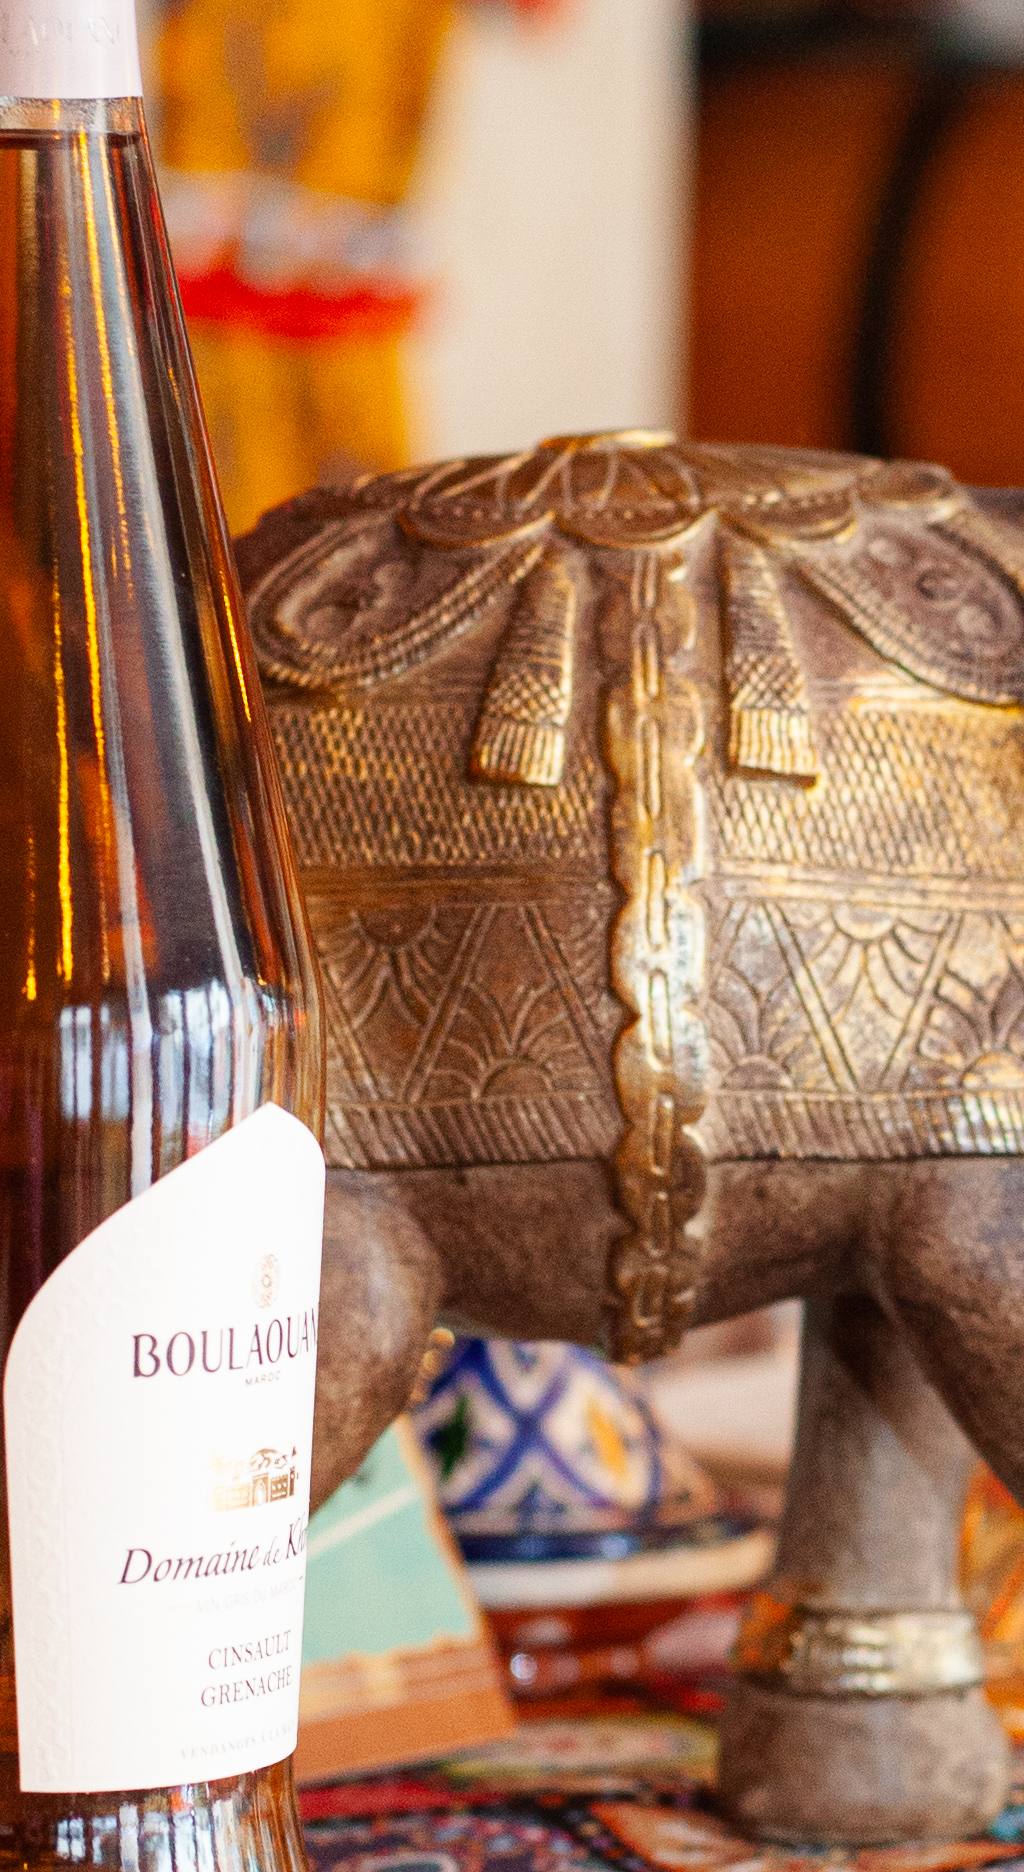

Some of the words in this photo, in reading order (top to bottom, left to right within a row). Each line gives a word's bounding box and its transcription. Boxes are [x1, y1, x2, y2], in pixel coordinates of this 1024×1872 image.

[244, 1369, 281, 1385] MAROC
[118, 1540, 261, 1585] Domaine
[262, 1536, 281, 1567] de
[207, 1629, 292, 1670] CINSAULT
[200, 1665, 293, 1707] GRENACHE
